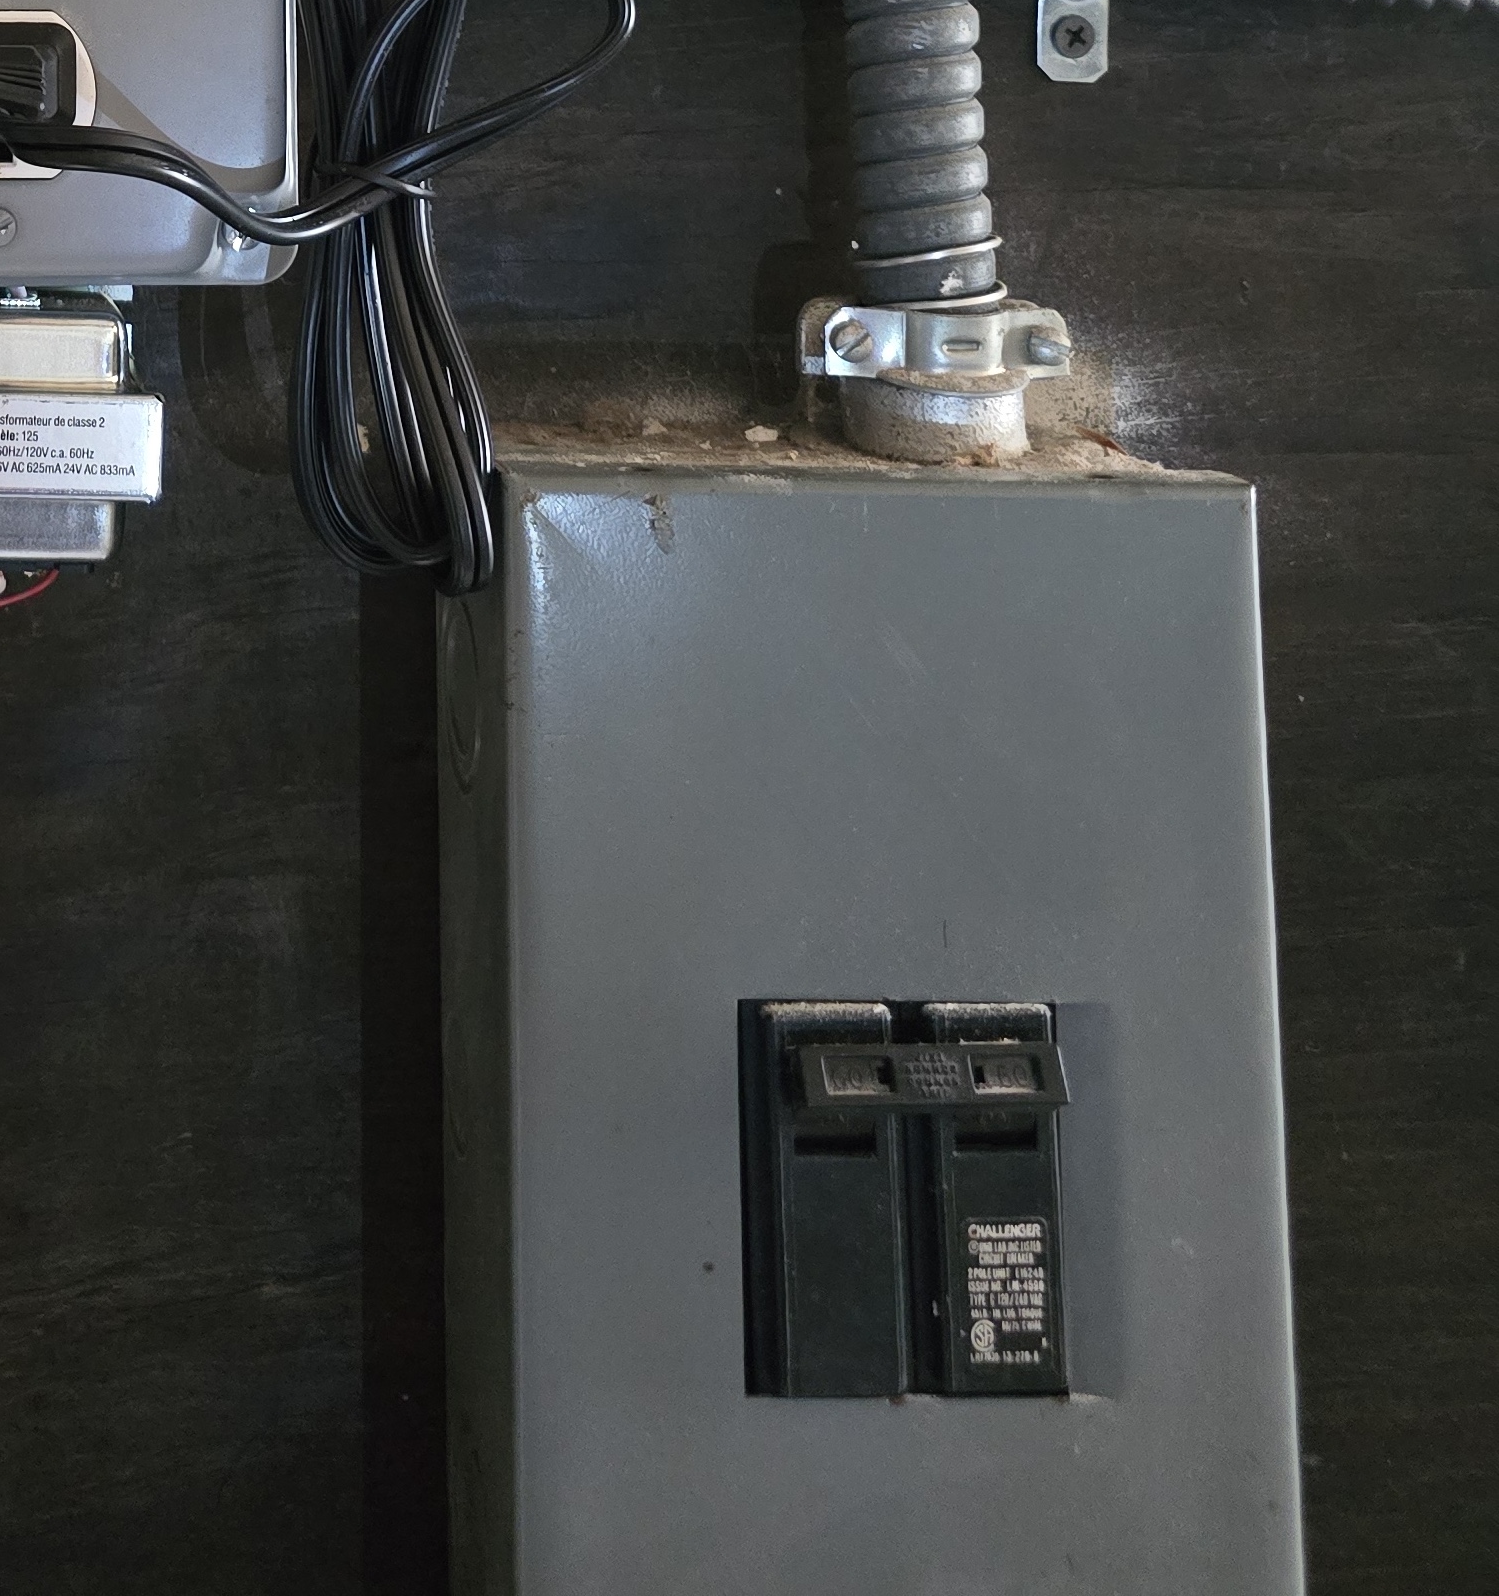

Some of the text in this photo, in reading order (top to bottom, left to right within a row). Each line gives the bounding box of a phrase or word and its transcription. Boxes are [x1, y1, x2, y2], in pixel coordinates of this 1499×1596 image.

[53, 415, 66, 427] de
[66, 416, 97, 428] classe
[98, 417, 105, 428] 2
[21, 431, 39, 442] 125
[50, 448, 67, 458] c.a.
[69, 447, 95, 460] 60Hz
[10, 461, 25, 473] AC
[26, 461, 62, 474] 625mA
[63, 462, 83, 475] 24V
[83, 463, 98, 475] AC
[100, 463, 136, 477] 833mA
[967, 1223, 1041, 1239] CHALLENGER
